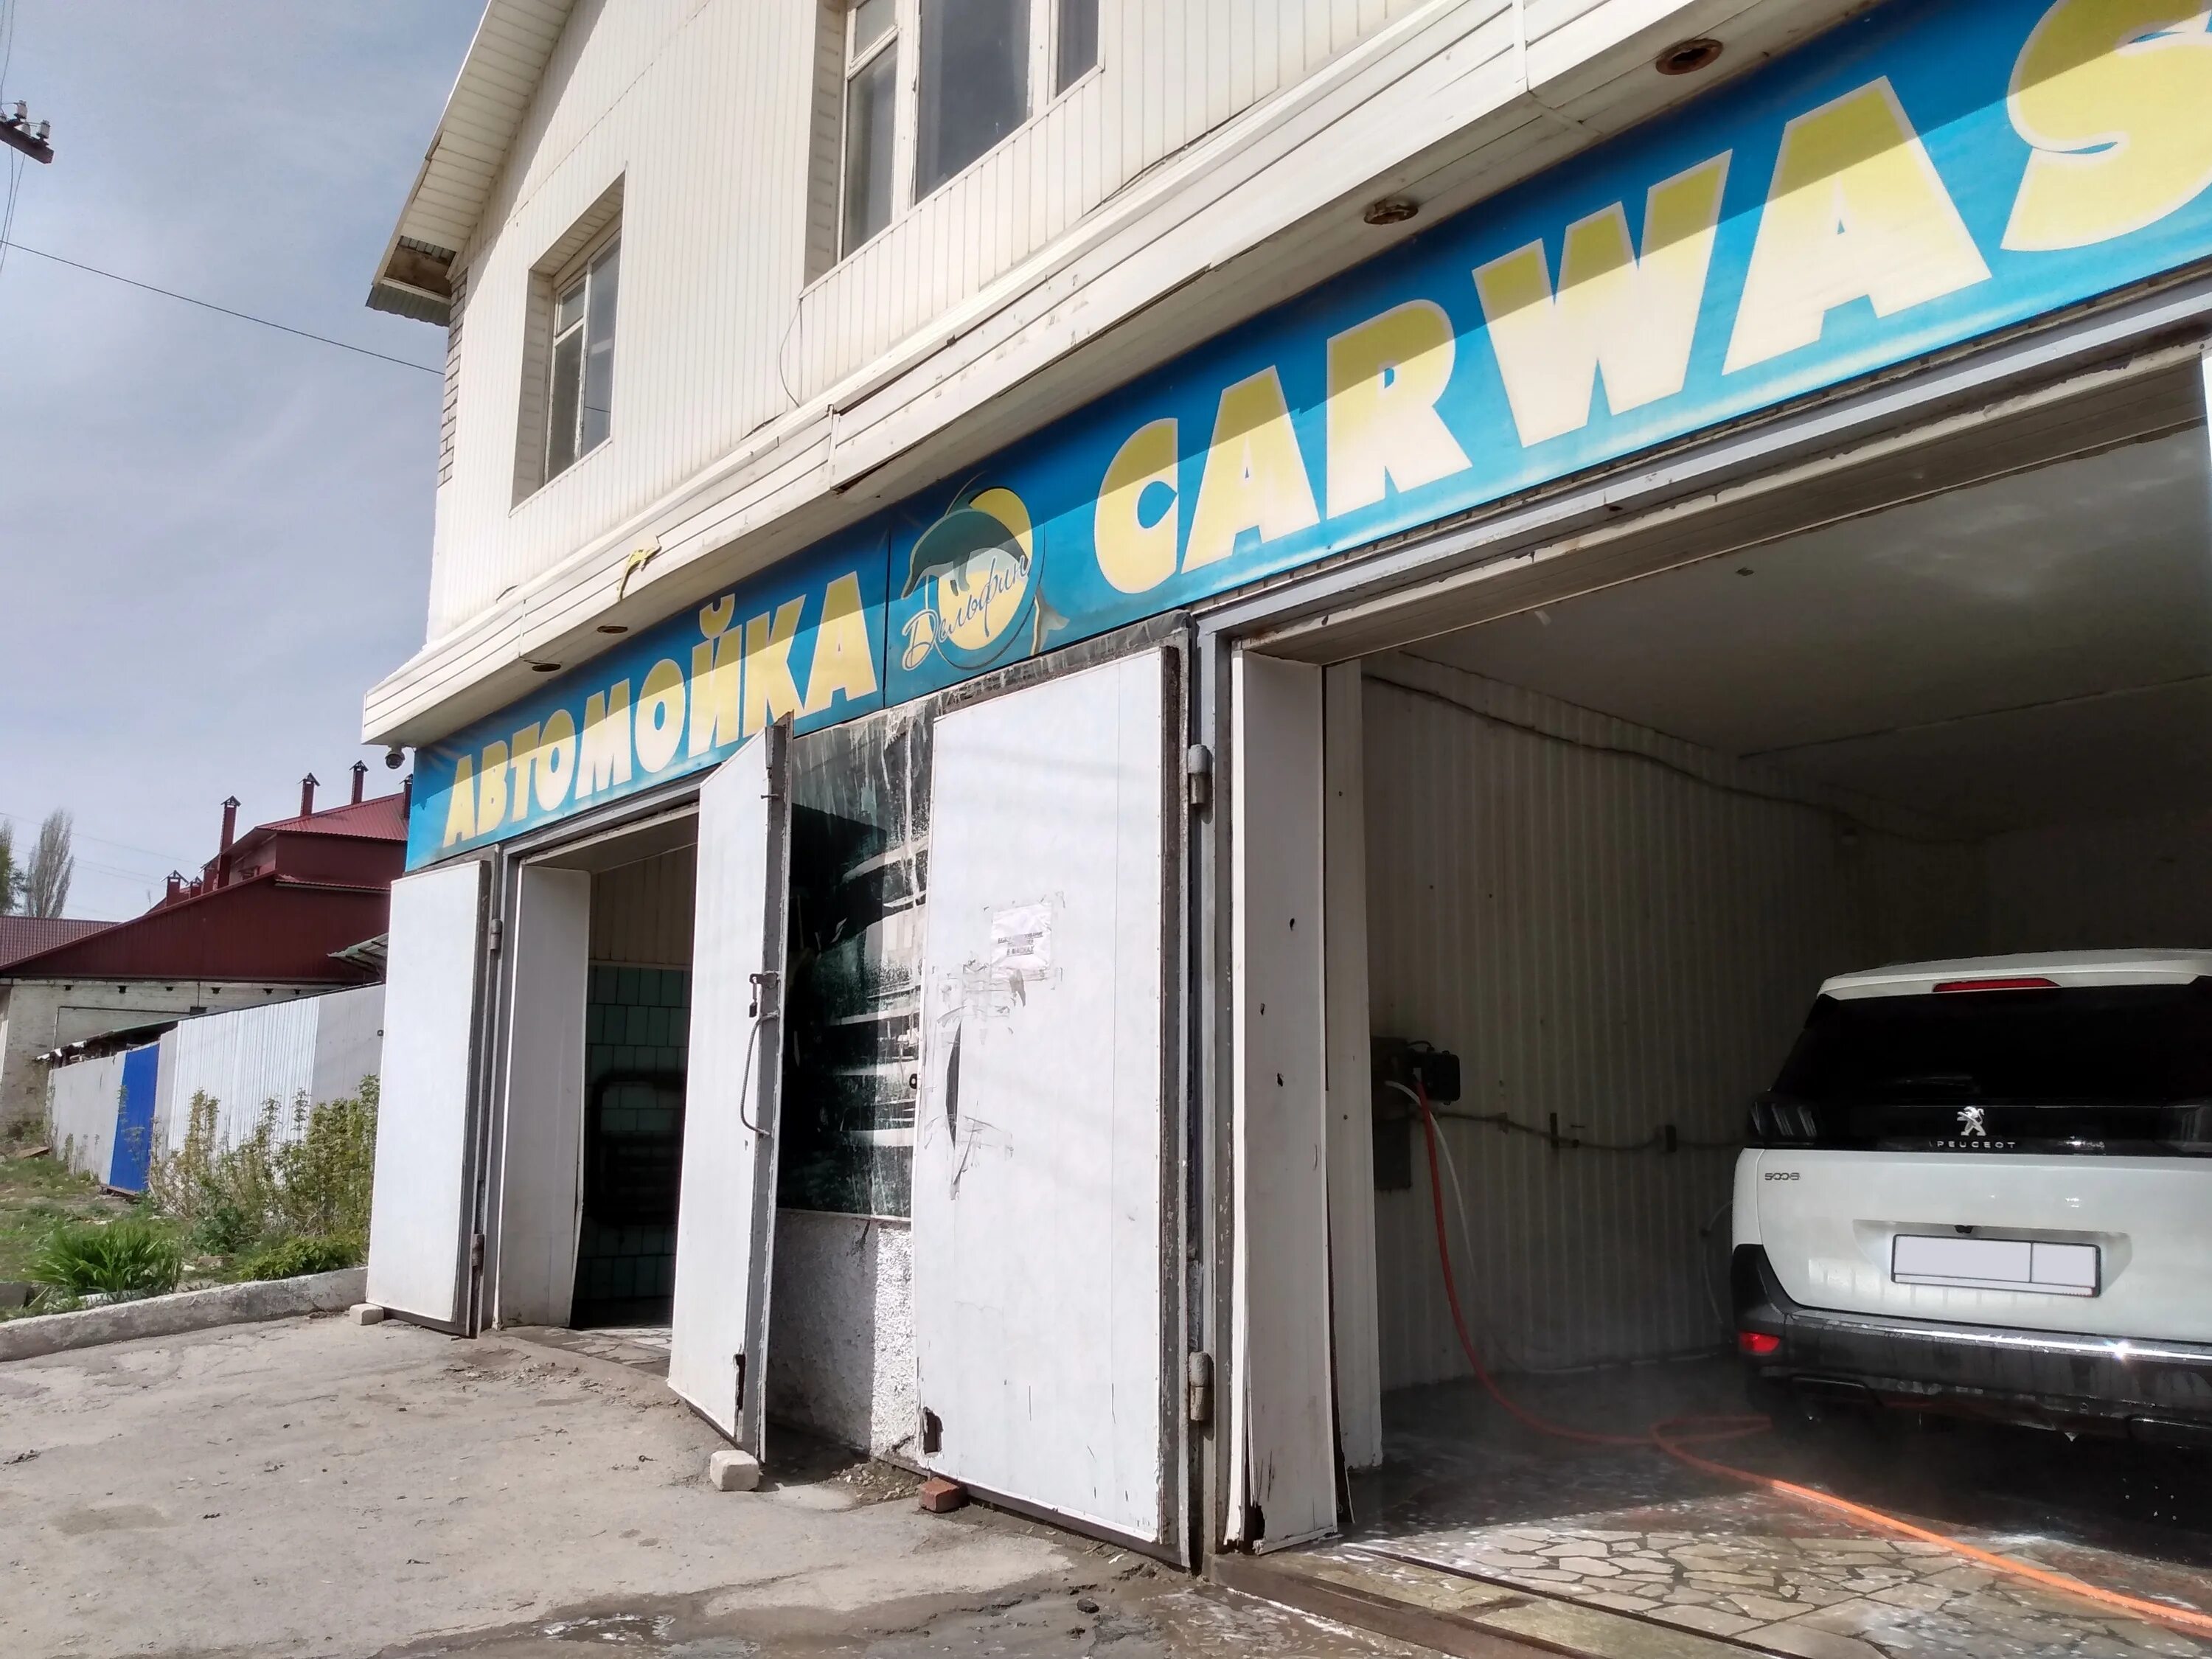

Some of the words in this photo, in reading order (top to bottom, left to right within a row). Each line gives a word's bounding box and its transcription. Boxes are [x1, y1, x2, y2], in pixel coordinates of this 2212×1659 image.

[902, 554, 1031, 671] Дельфин
[442, 571, 877, 848] АВТОМОЙКА
[1764, 1172, 1800, 1180] 5008
[1936, 1141, 2016, 1149] PEUGEOT
